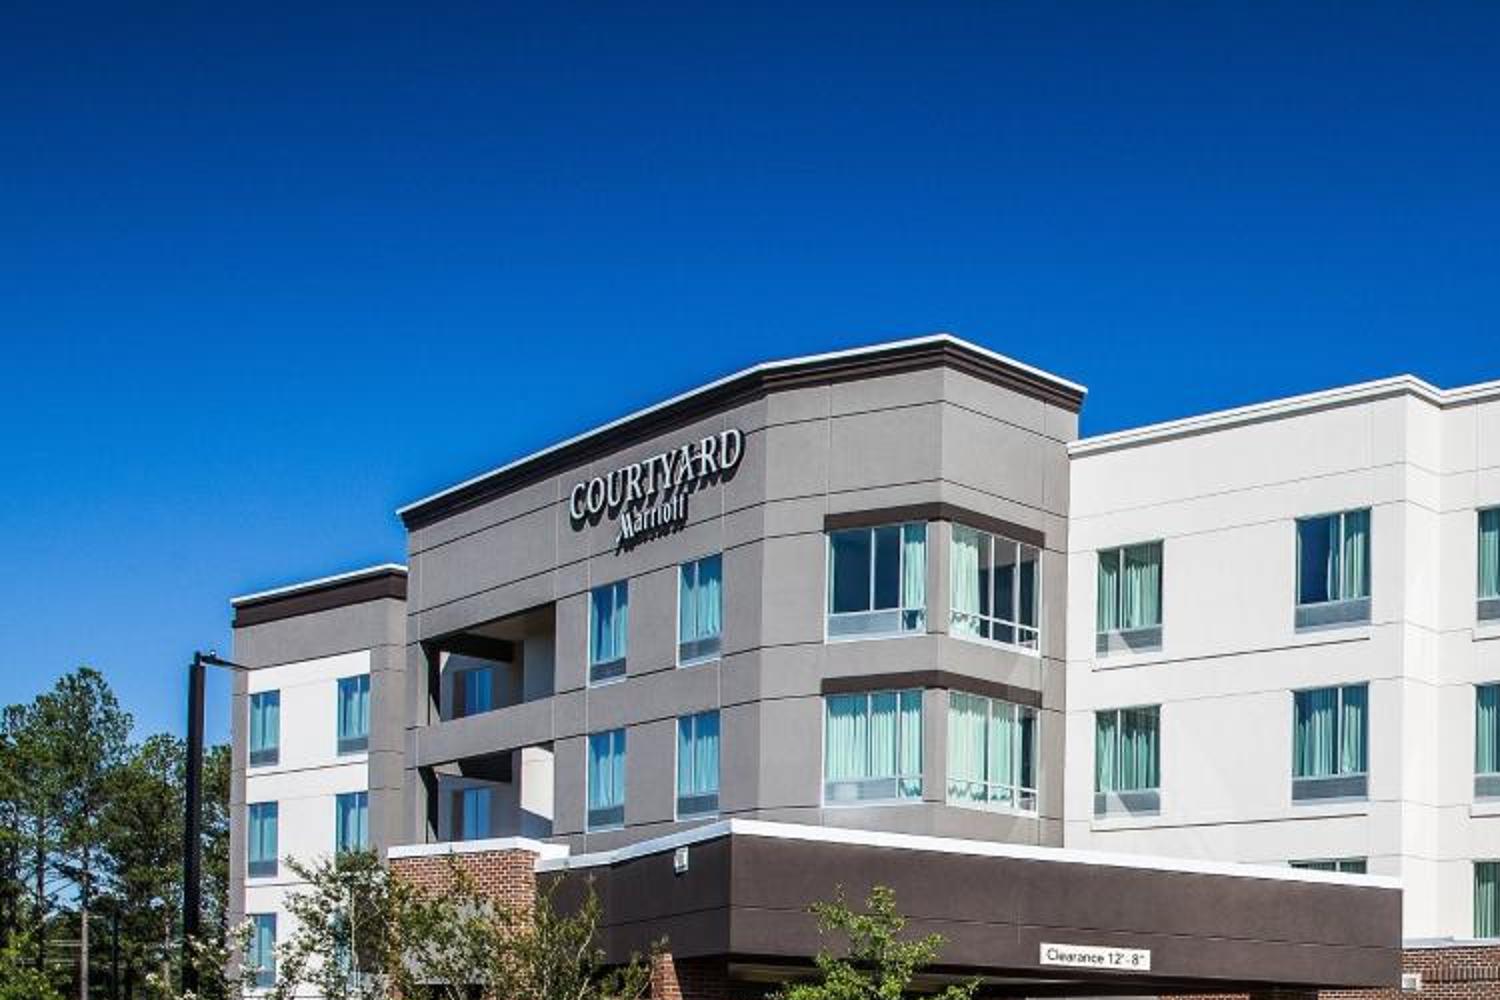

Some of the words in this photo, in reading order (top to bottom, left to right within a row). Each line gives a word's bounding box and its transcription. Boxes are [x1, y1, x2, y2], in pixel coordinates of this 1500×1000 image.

[569, 428, 743, 520] COURTYARD
[615, 492, 686, 544] Marriott
[1047, 947, 1105, 965] Clearance
